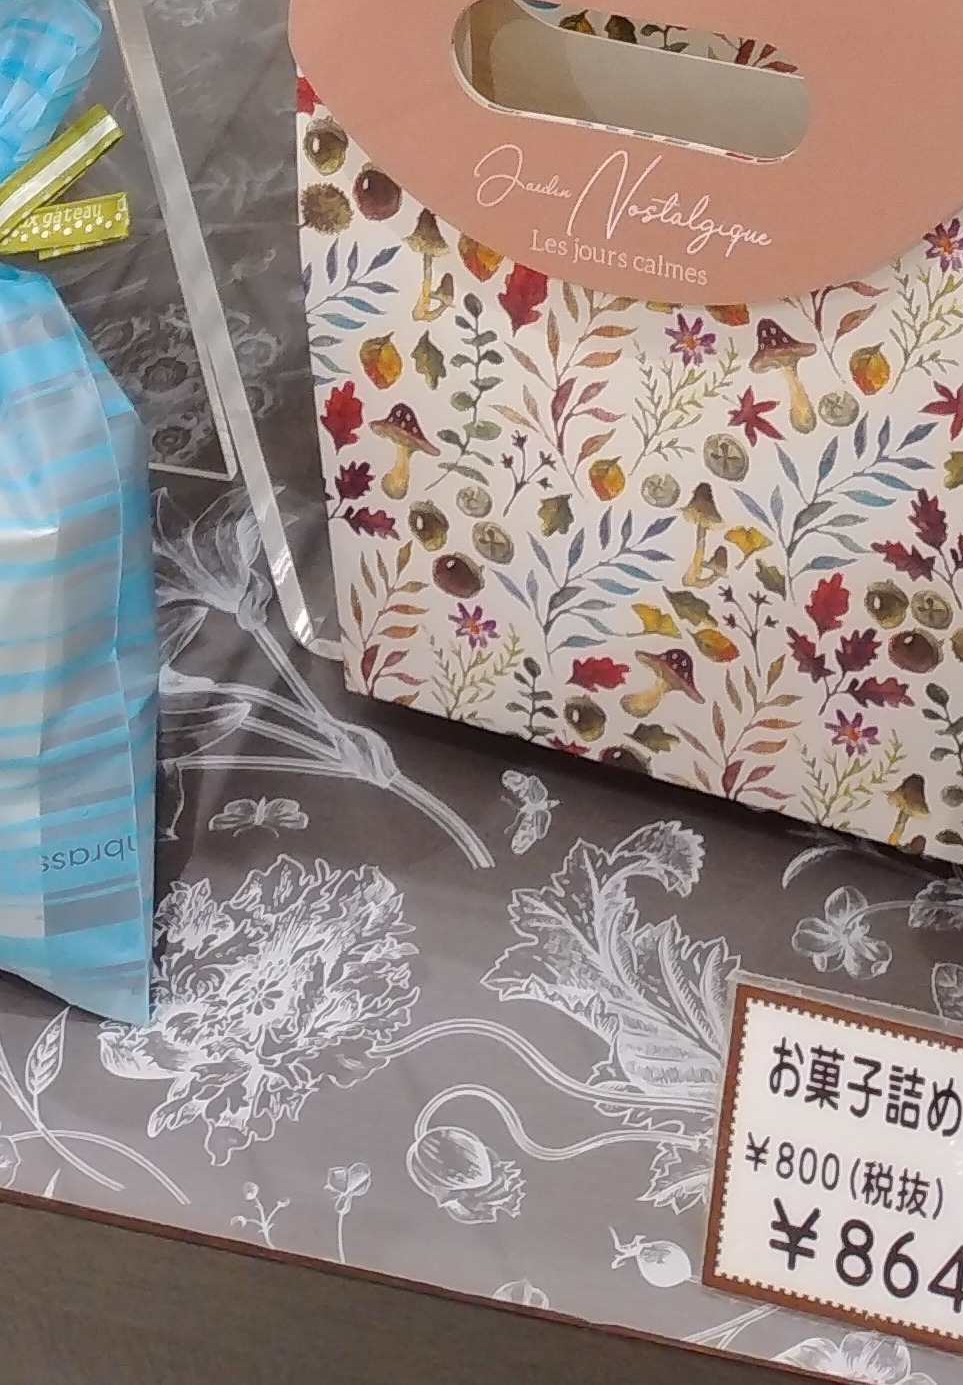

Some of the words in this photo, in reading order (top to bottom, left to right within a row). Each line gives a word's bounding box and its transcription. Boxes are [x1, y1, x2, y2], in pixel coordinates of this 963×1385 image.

[566, 149, 774, 258] Nostalgique
[528, 228, 568, 257] Les
[572, 236, 628, 269] jours
[632, 252, 709, 286] calmes
